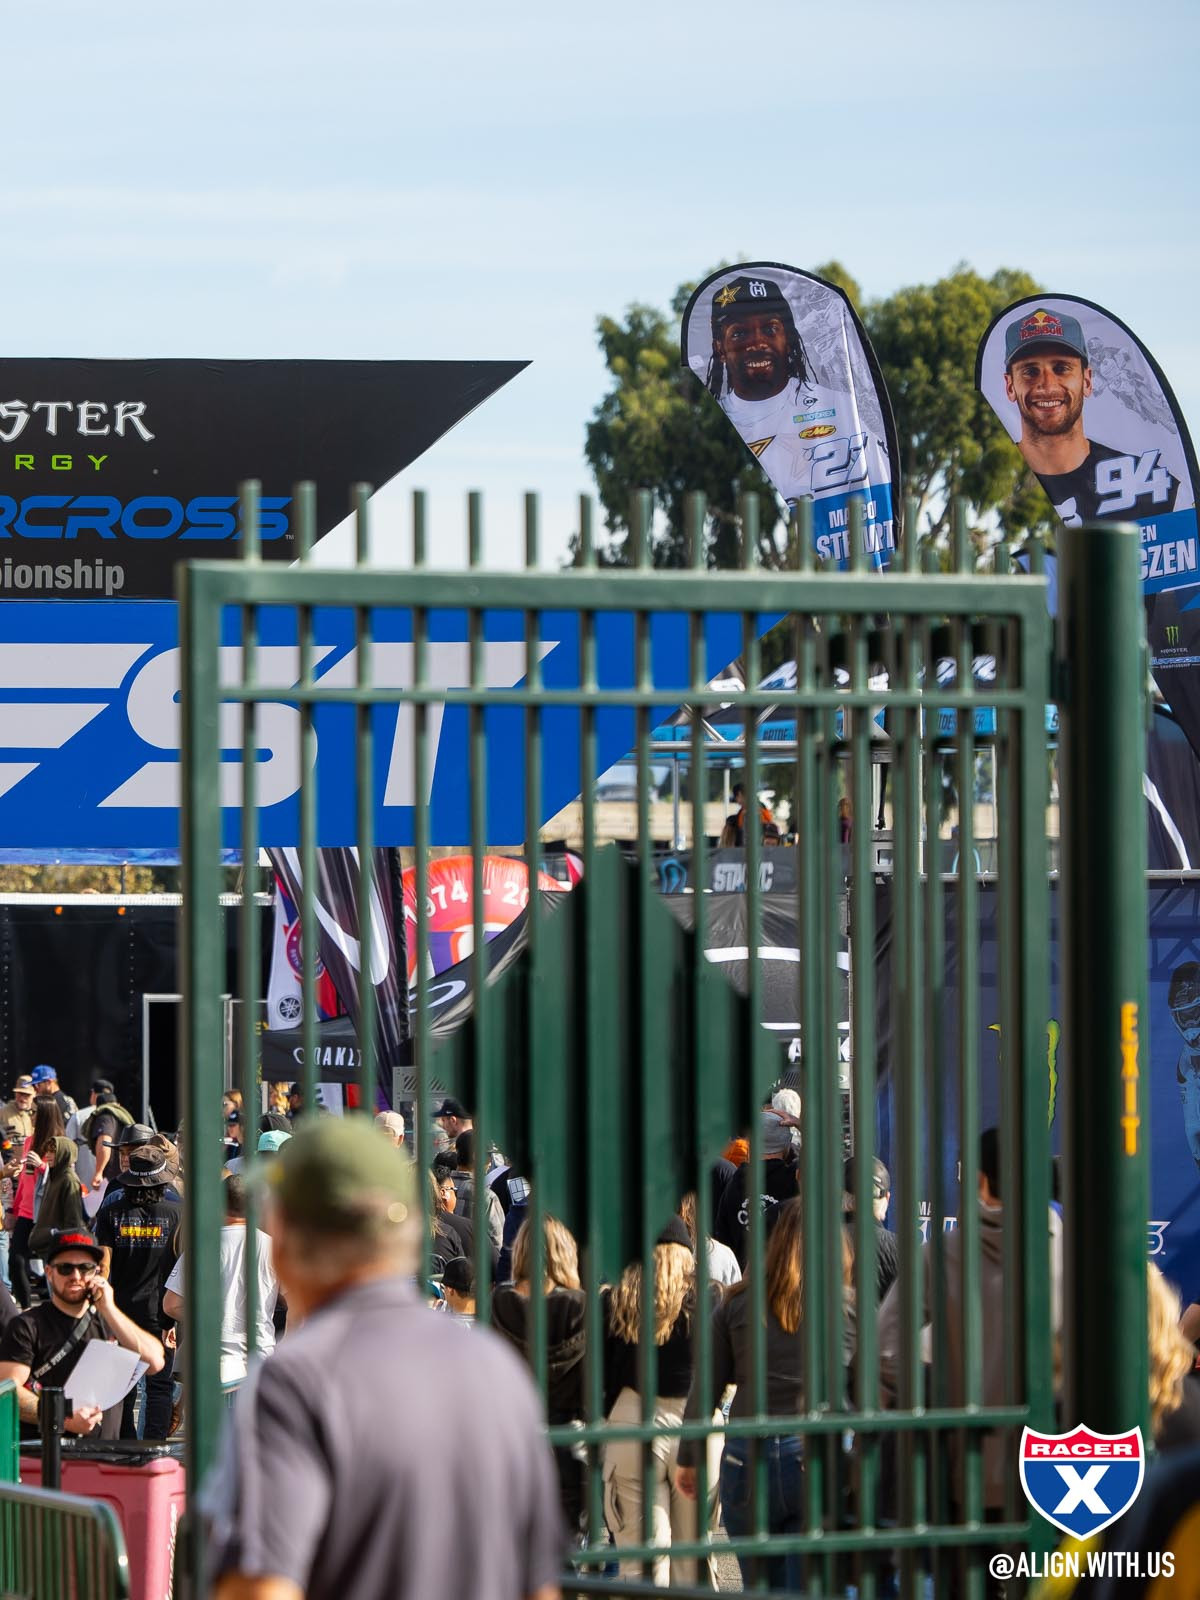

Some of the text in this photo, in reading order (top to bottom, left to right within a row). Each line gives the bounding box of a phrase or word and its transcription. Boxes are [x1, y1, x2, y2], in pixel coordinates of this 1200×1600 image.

[1094, 449, 1171, 516] 94
[713, 862, 774, 892] STAC
[313, 1046, 362, 1067] OAKL
[1120, 1001, 1141, 1156] EXIT
